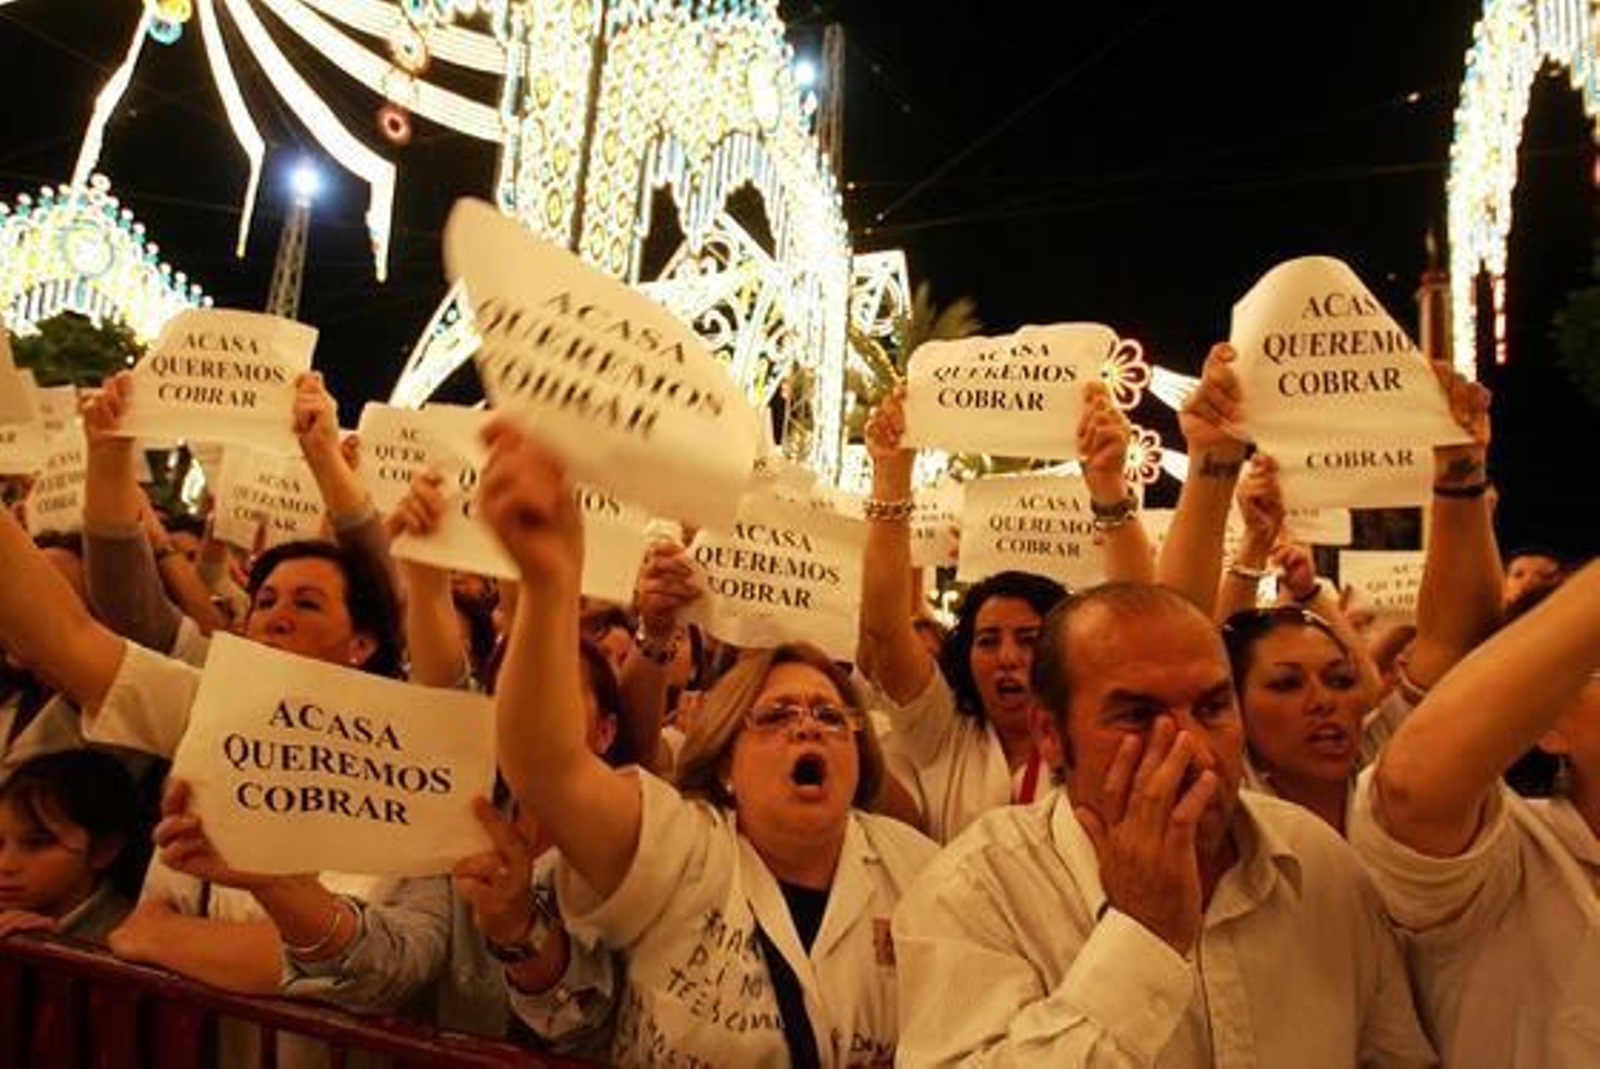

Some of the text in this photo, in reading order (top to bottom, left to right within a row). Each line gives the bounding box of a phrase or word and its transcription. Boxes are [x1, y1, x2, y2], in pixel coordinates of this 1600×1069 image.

[1301, 292, 1377, 318] ACAS
[551, 292, 684, 364] ACASA
[183, 333, 259, 354] ACASA
[1263, 329, 1410, 364] QUEREMO
[150, 355, 286, 384] QUEREMOS
[933, 364, 1077, 383] QUEREMOS
[1278, 367, 1402, 397] COBRAR
[158, 383, 257, 409] COBRAR
[937, 388, 1046, 412] COBRAR
[1306, 450, 1414, 468] COBRAR
[1016, 496, 1082, 512] ACASA
[732, 522, 812, 552] ACASA
[989, 516, 1093, 534] QUEREMO
[995, 538, 1081, 557] COBRAR
[695, 546, 841, 585] QUEREMOS
[269, 700, 404, 751] ACASA
[223, 732, 452, 794] QUEREMOS
[236, 781, 410, 825] COBRAR
